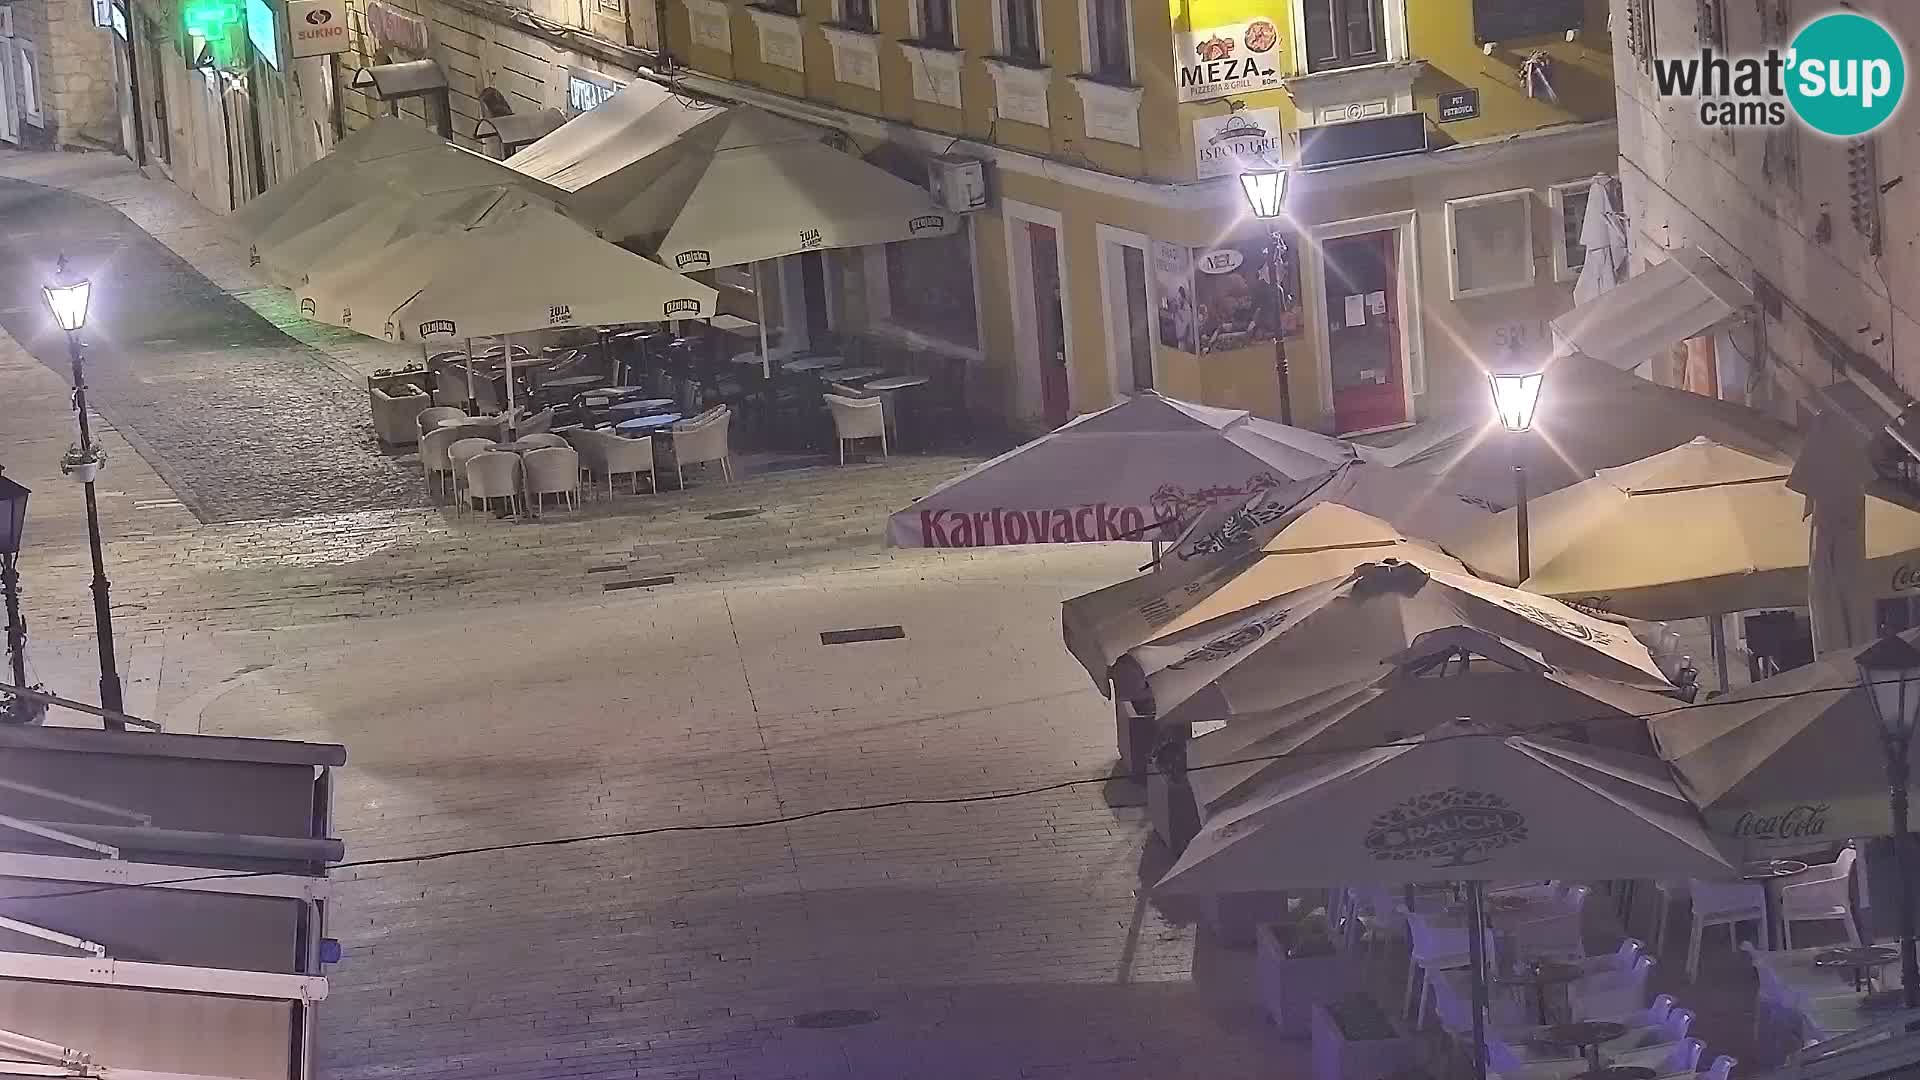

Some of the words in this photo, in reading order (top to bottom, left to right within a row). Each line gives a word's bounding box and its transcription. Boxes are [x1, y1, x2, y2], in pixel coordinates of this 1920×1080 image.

[298, 26, 343, 40] SUKNO
[1181, 57, 1260, 88] MEZA
[1191, 84, 1223, 96] PIZZERIA
[1230, 79, 1252, 89] GRILL
[920, 502, 1146, 548] Karlovačko
